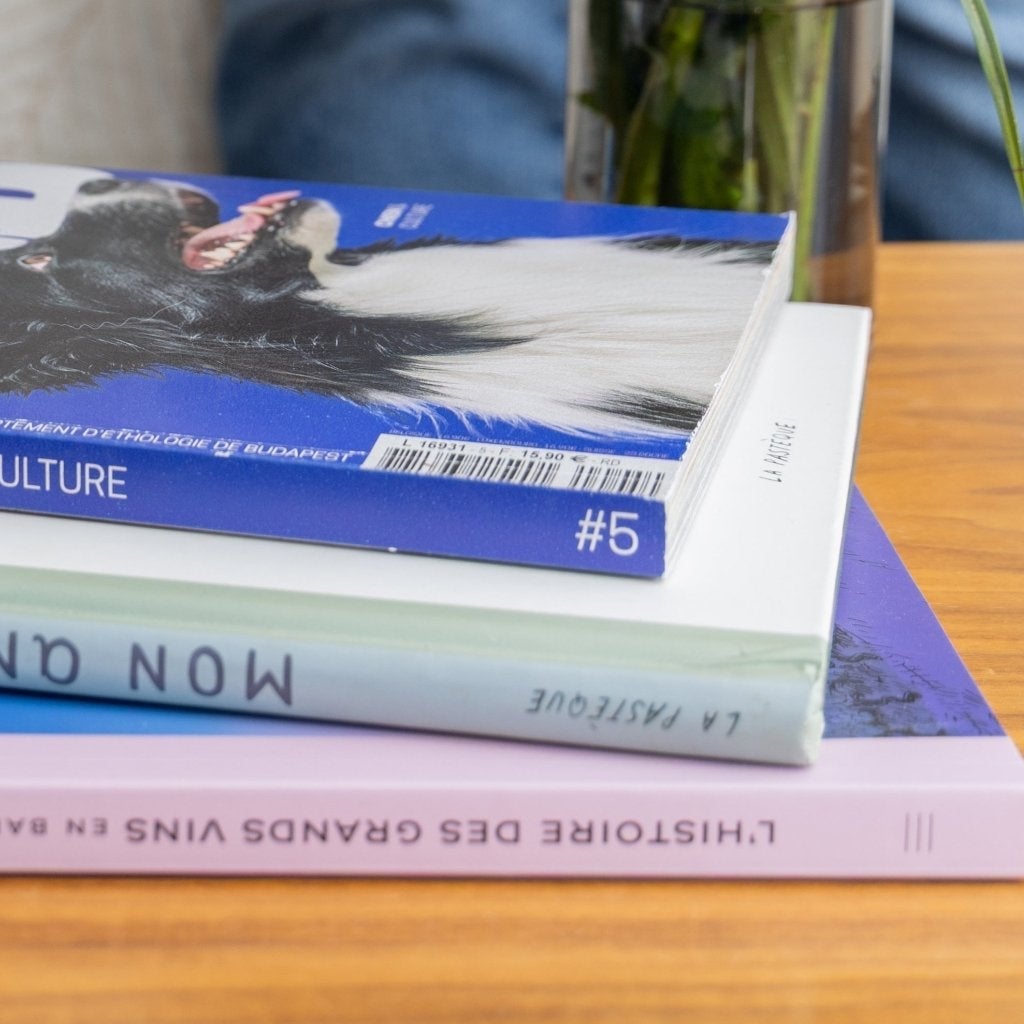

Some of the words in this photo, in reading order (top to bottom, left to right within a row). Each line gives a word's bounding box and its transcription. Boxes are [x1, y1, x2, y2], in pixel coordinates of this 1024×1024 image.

[214, 439, 240, 452] DE
[244, 443, 353, 463] BUDAPEST
[420, 440, 467, 452] 16931
[758, 469, 783, 483] LA
[575, 509, 640, 556] #5
[128, 642, 293, 706] MON
[702, 710, 742, 735] LA
[66, 817, 109, 836] EN
[126, 817, 226, 843] VINS
[243, 817, 423, 844] GRANDS
[439, 819, 521, 845] DES
[541, 819, 777, 846] L'HISTOIRE
